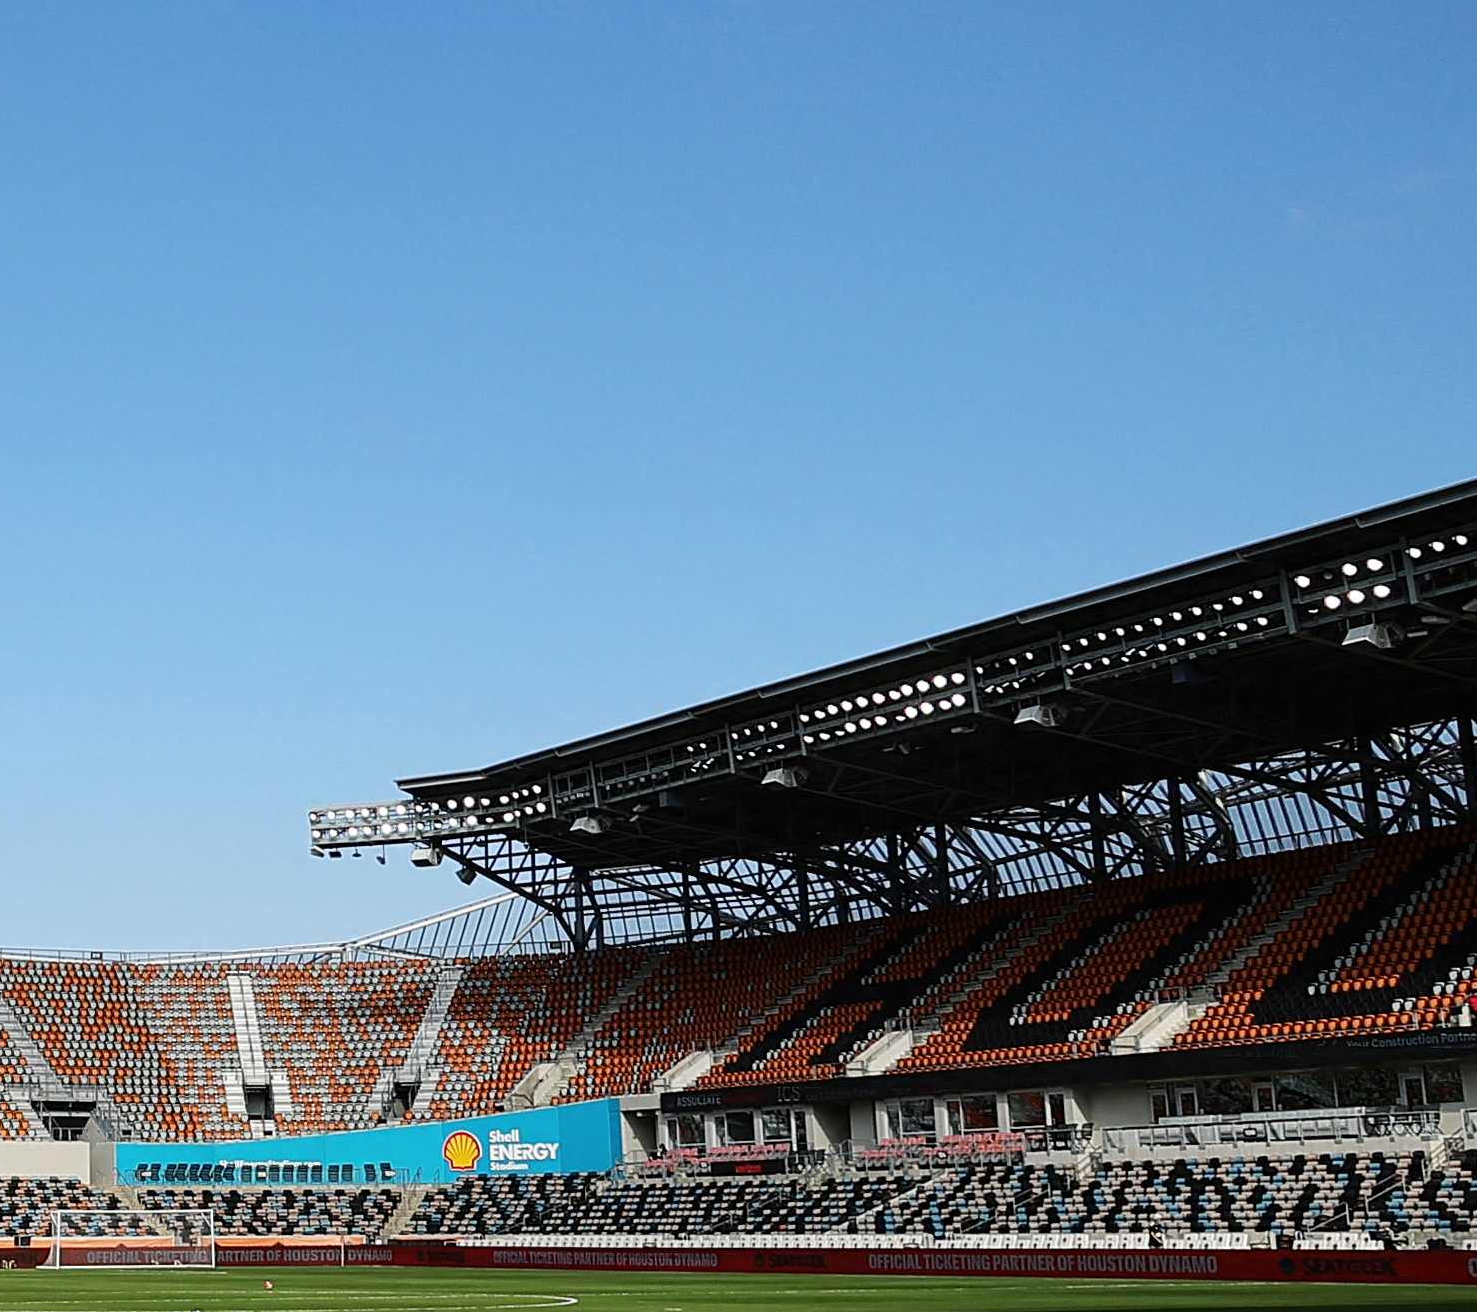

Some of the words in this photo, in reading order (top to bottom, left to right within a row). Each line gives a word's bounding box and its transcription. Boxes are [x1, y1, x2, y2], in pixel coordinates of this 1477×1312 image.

[1371, 1034, 1438, 1048] Construction
[488, 1129, 520, 1143] Shell
[489, 1143, 560, 1161] ENERGY
[216, 1249, 265, 1263] ARTNER
[266, 1249, 283, 1263] OF
[283, 1249, 341, 1263] HOUSTON
[344, 1249, 393, 1263] DYNAMO
[675, 1253, 719, 1268] DYNAMO
[870, 1253, 922, 1271] OFFICIAL
[923, 1254, 991, 1271] TICKETING
[992, 1254, 1055, 1272] PARTNER
[1056, 1255, 1075, 1272] OF
[1077, 1255, 1149, 1273] HOUSTON
[1150, 1255, 1218, 1274] DYNAMO
